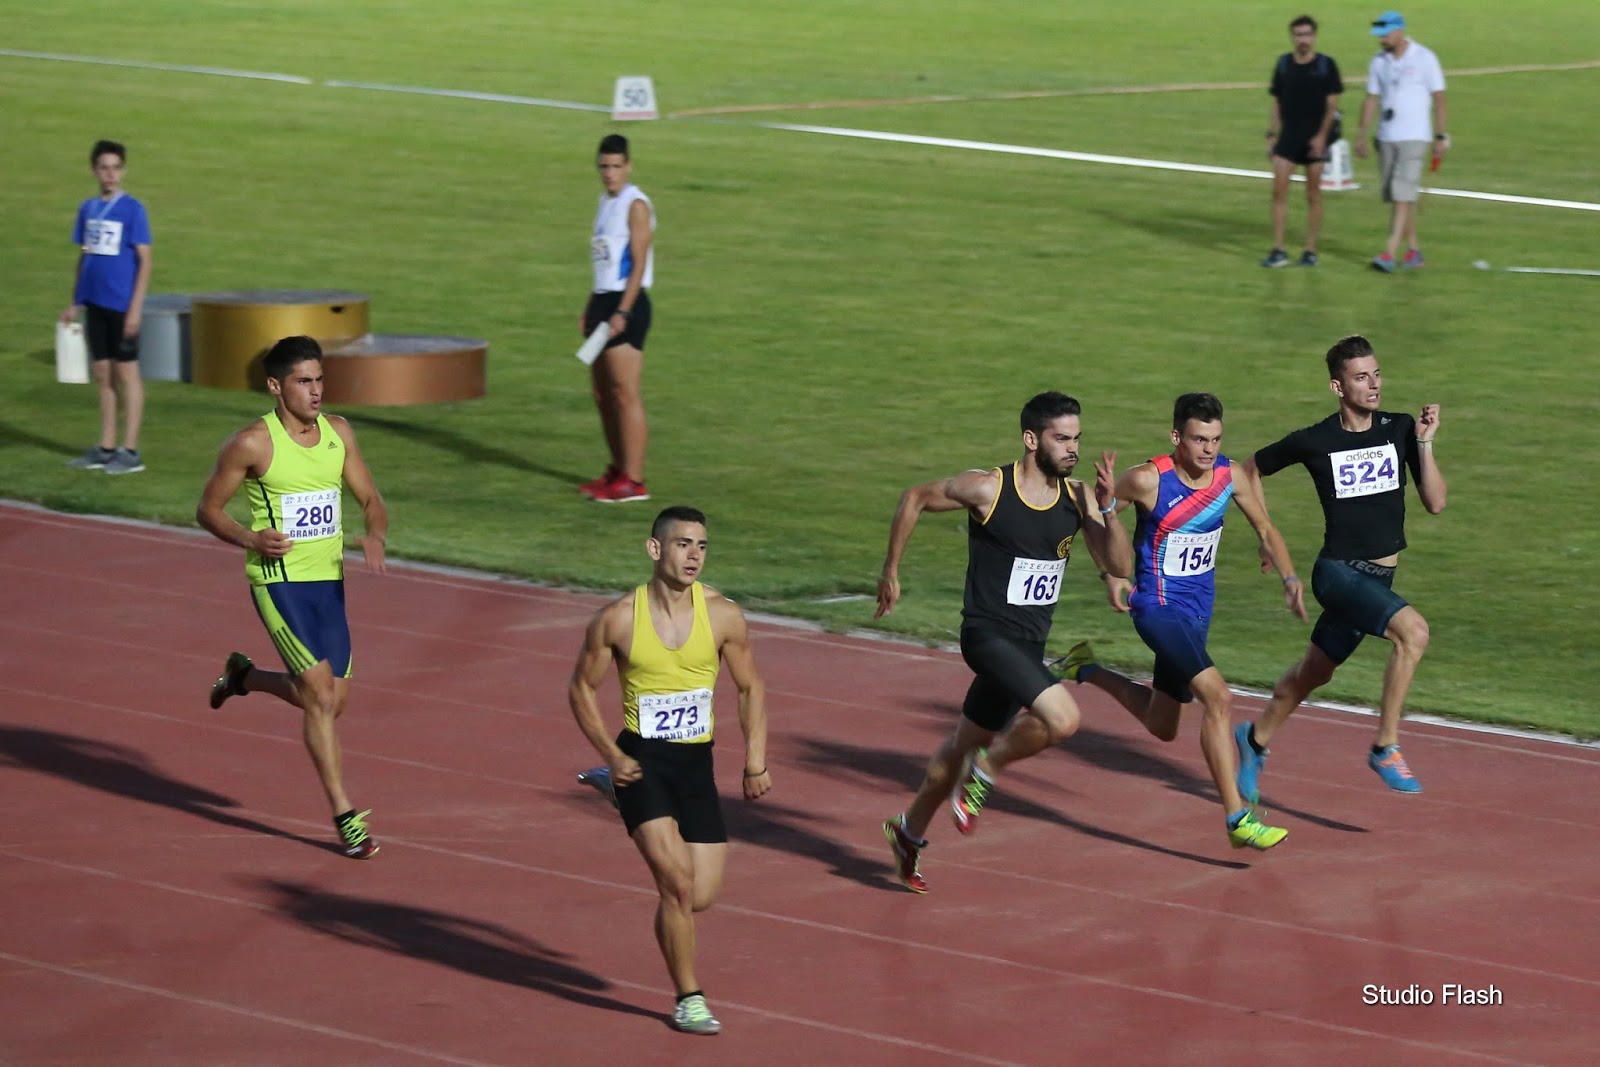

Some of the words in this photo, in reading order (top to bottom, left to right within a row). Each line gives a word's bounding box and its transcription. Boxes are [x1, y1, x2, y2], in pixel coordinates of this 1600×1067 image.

[622, 88, 648, 108] 50
[1346, 450, 1384, 462] adidas
[1339, 457, 1395, 486] 524
[296, 505, 333, 527] 280
[1179, 544, 1214, 571] 154
[1024, 574, 1058, 601] 163
[655, 705, 698, 731] 273
